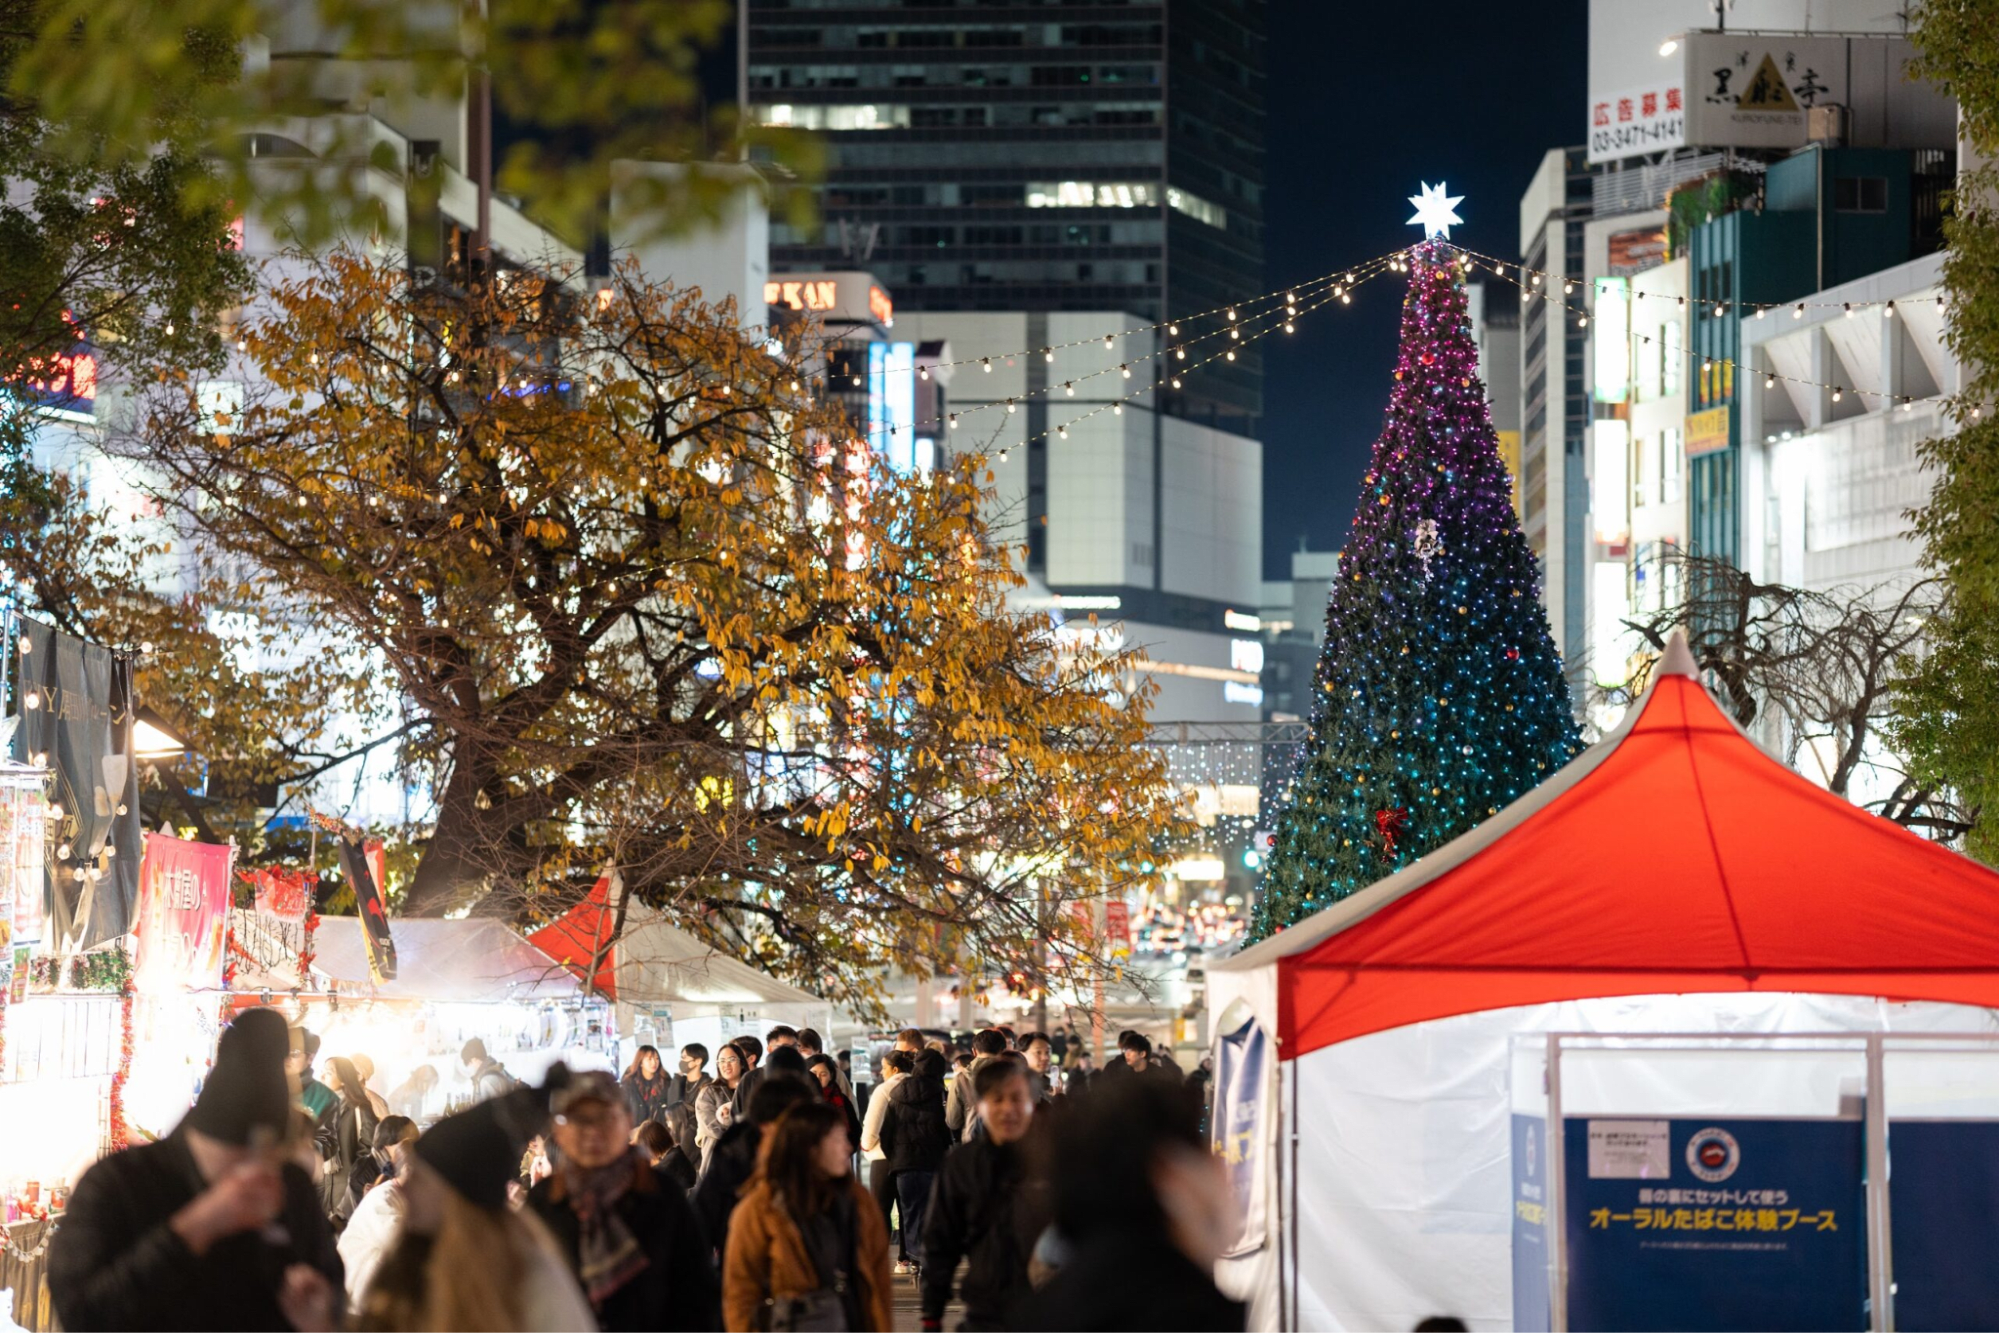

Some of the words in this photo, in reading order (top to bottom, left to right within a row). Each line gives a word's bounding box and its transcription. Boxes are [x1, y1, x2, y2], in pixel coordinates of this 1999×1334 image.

[1593, 87, 1683, 127] 広告募集
[1592, 116, 1684, 153] 03-3471-4141
[1589, 1208, 1838, 1231] オーラルたばこ体験ブース
